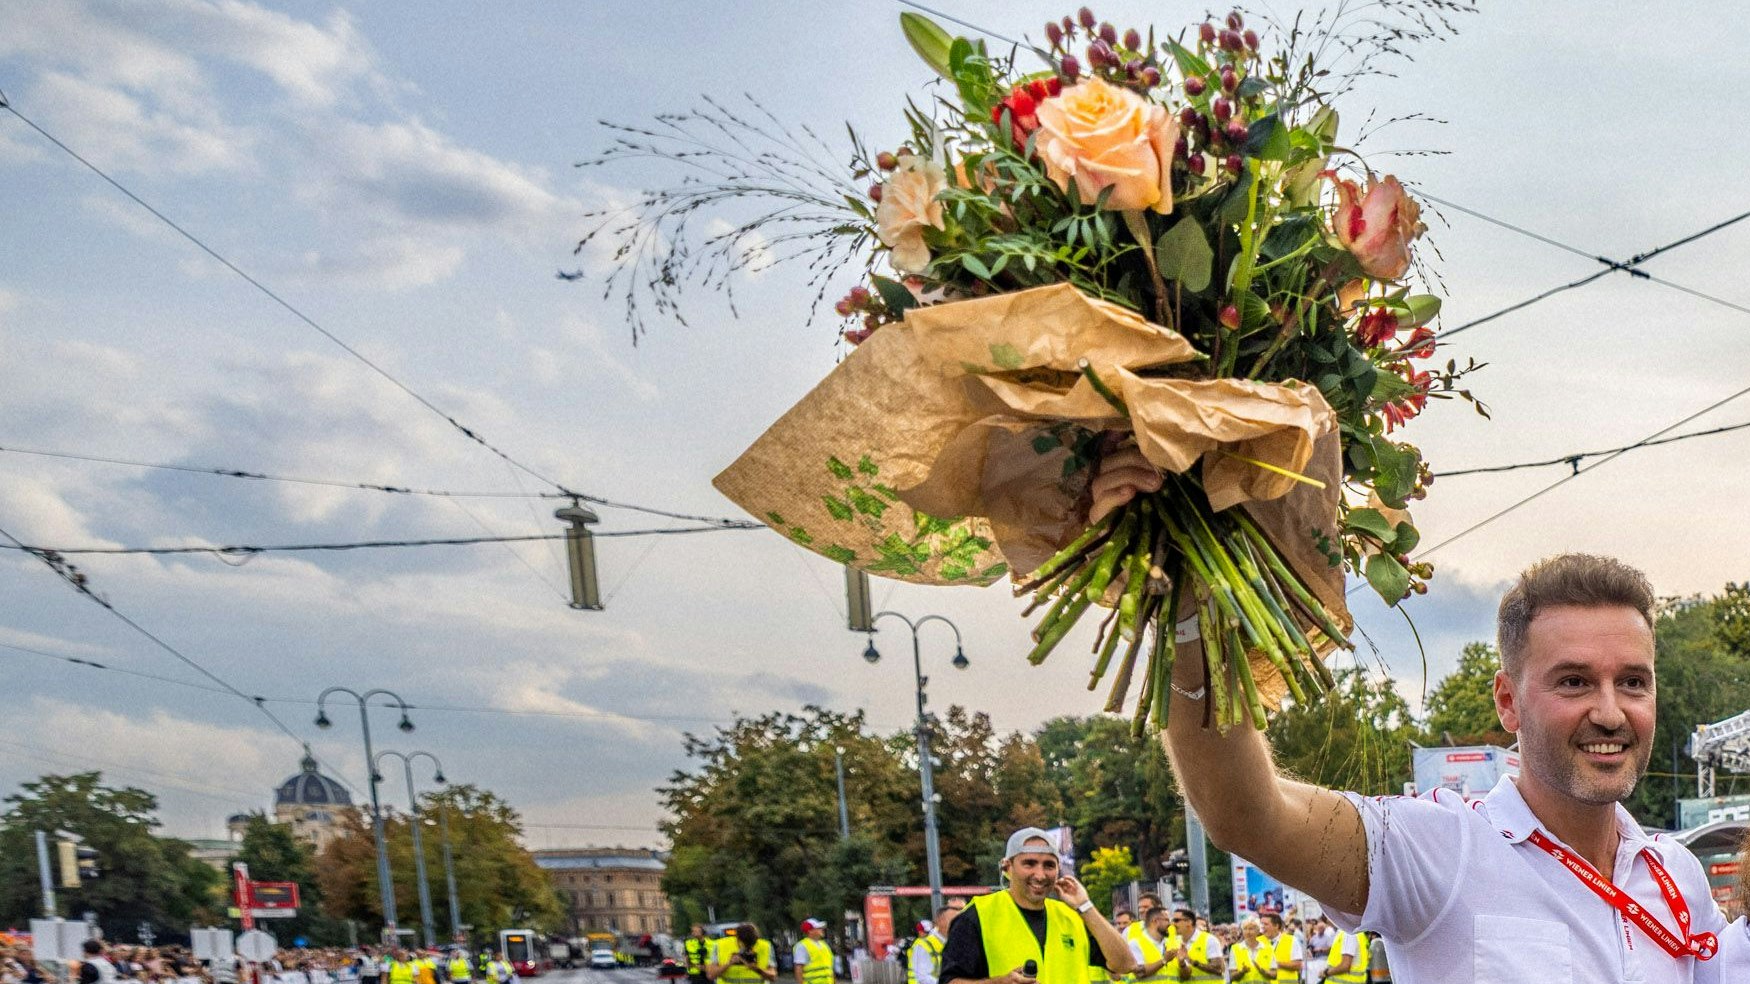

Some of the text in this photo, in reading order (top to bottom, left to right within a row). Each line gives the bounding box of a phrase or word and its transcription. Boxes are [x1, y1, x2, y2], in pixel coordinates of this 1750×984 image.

[1566, 858, 1617, 898] WIENER LINIEN
[1661, 875, 1678, 900] LINIEN
[1640, 913, 1664, 937] WIENER
[1660, 933, 1680, 952] LINIEN
